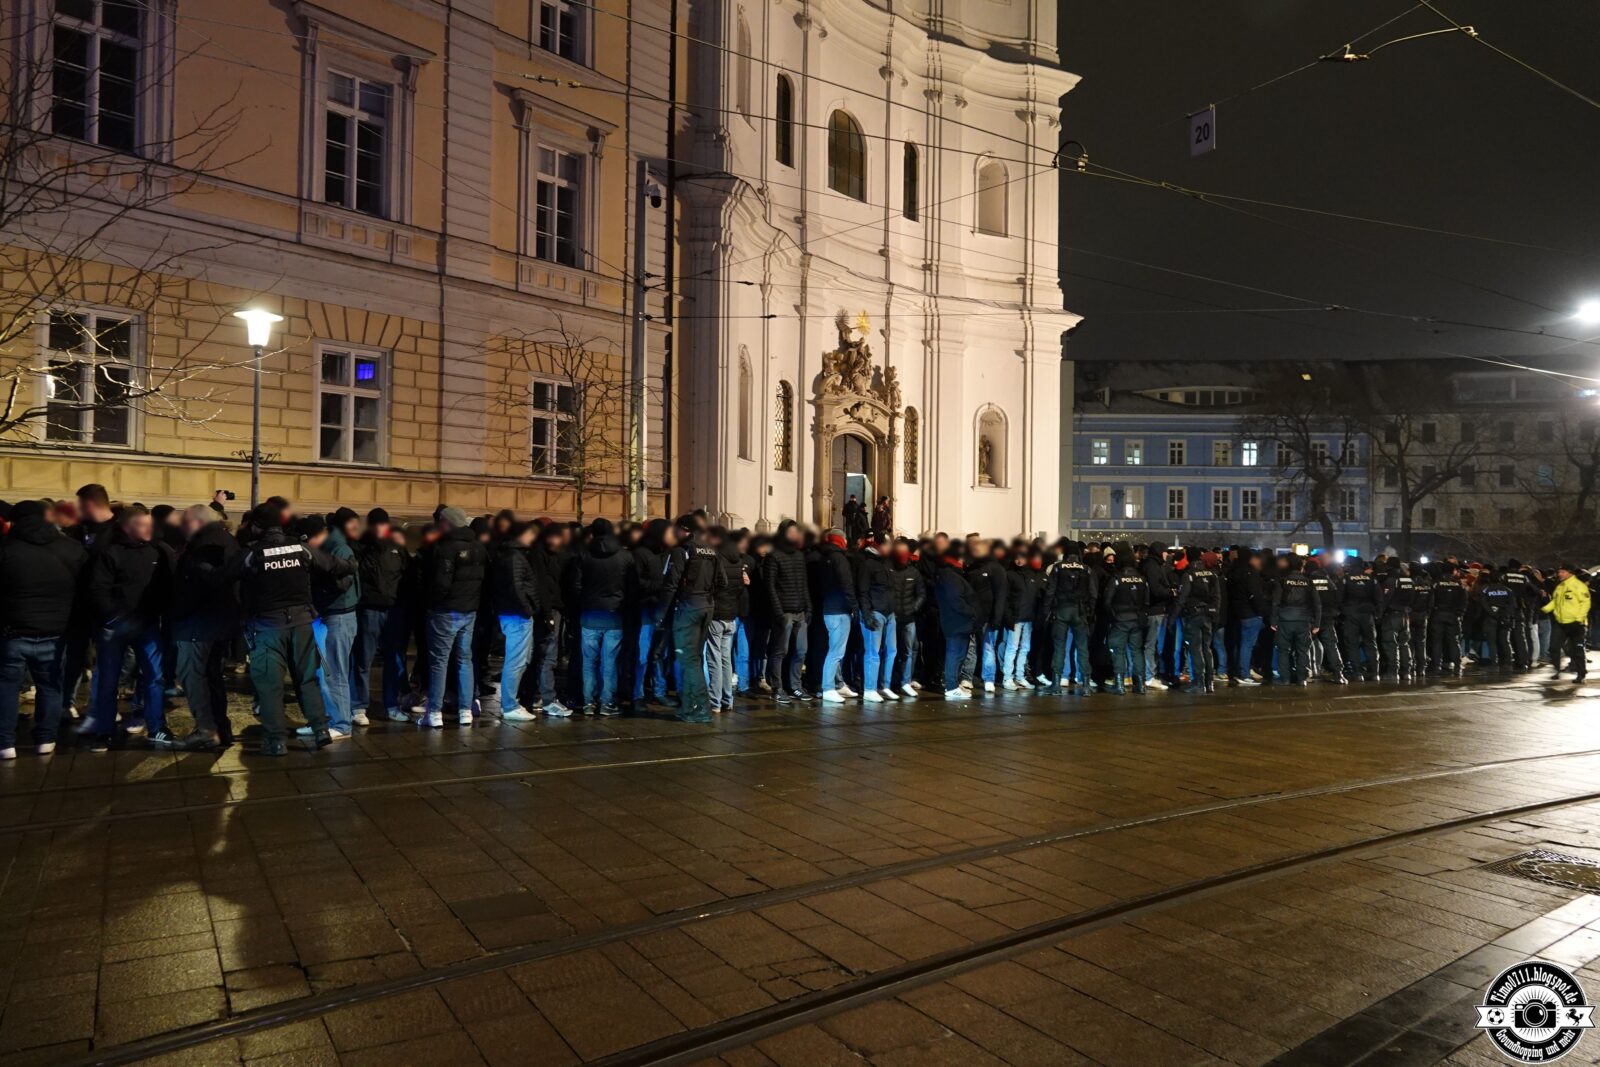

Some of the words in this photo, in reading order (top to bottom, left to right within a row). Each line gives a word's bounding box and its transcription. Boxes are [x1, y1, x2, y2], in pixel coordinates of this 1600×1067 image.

[1195, 122, 1210, 144] 20
[264, 558, 300, 571] POLÍCIA
[1061, 562, 1085, 570] POLÍCIA
